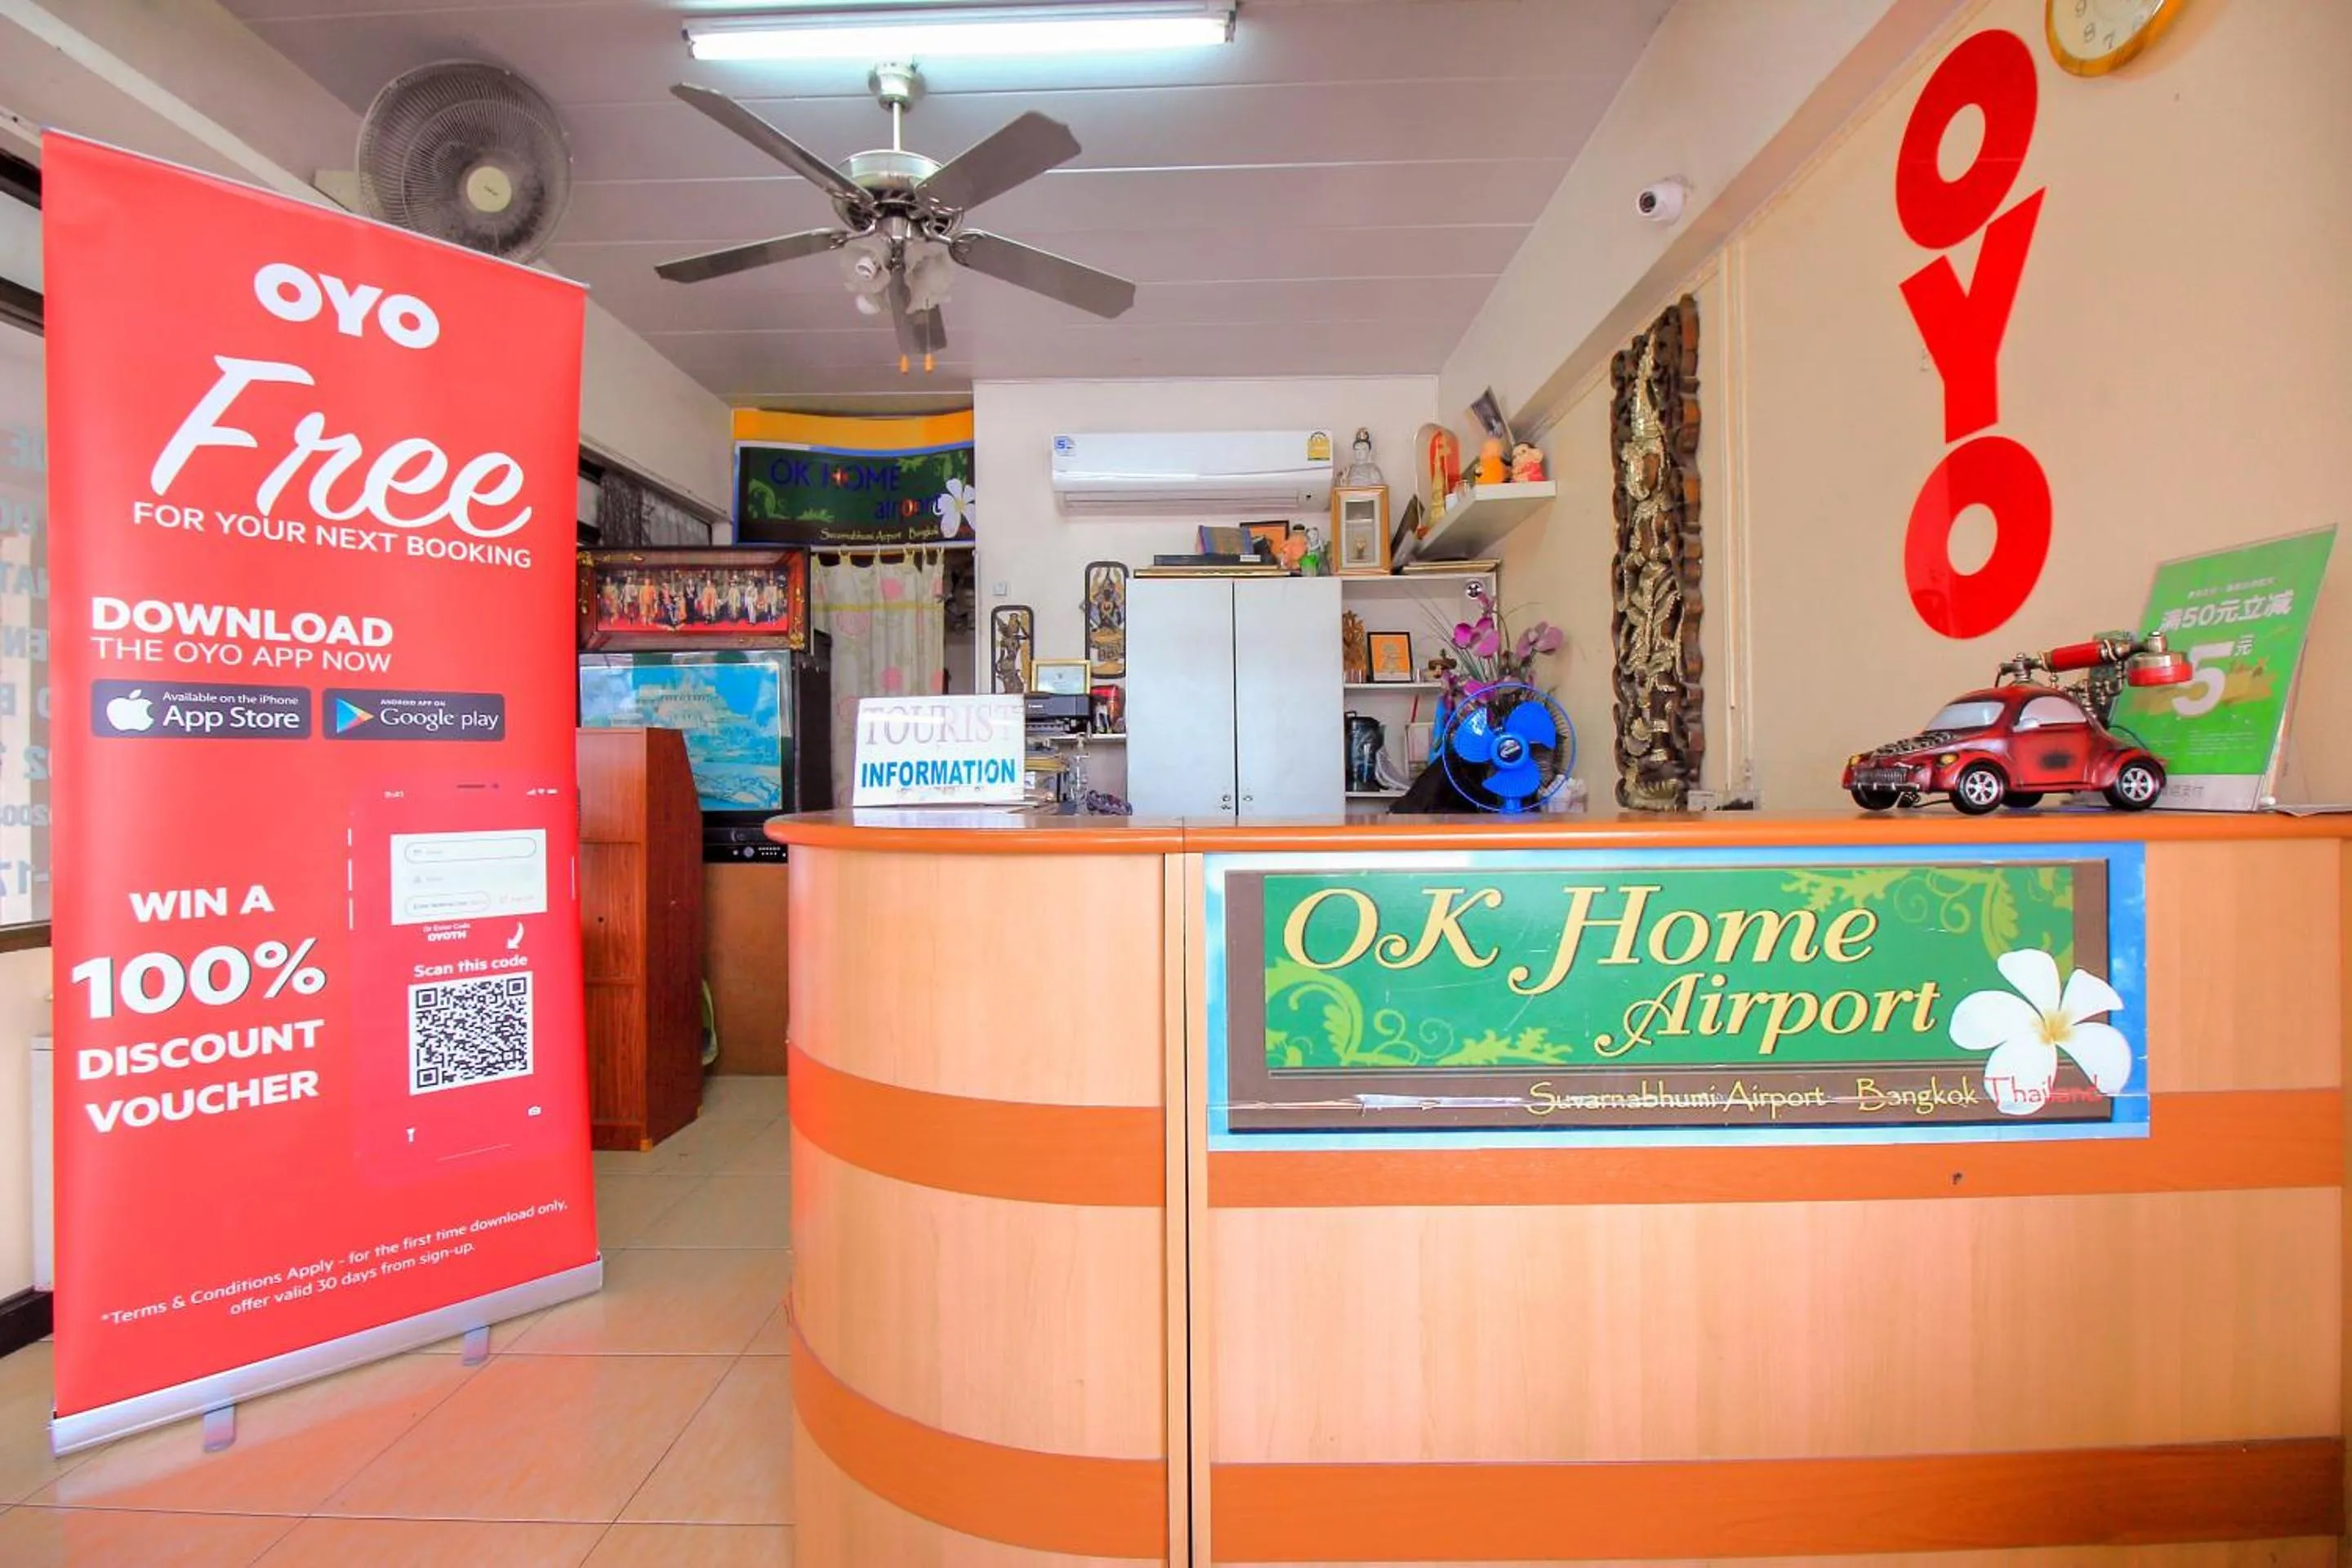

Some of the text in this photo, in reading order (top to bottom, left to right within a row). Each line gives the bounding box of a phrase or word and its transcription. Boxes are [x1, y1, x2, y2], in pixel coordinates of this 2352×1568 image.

[253, 262, 440, 349] OYO
[1895, 29, 2053, 639] OYO
[150, 354, 532, 538] Free
[133, 501, 532, 568] FOR YOUR NEXT BOOKING
[91, 597, 394, 647] DOWNLOAD
[91, 637, 392, 673] THE OYO APP NOW
[163, 692, 299, 706] Available on the iPhone
[163, 706, 300, 733] App Store
[380, 708, 499, 732] Google play
[861, 759, 1016, 788] INFORMATION
[128, 884, 276, 923] WIN A
[413, 954, 528, 978] Scan this code
[1283, 885, 1880, 996] OK Home
[71, 937, 327, 1021] 100%
[1593, 972, 1940, 1058] Airport
[78, 1019, 325, 1080] DISCOUNT
[85, 1071, 319, 1134] VOUCHER
[1526, 1074, 2103, 1120] Suvarnabhumi Airport Bangkok Thailand
[172, 1295, 186, 1309] &
[190, 1274, 283, 1305] Conditions
[287, 1258, 334, 1285] Apply
[348, 1250, 370, 1263] for
[375, 1243, 399, 1258] the
[403, 1232, 433, 1251] first
[436, 1224, 467, 1241] time
[470, 1205, 535, 1232] download
[229, 1295, 270, 1316] offer
[274, 1281, 314, 1303] valid
[317, 1276, 337, 1293] 30
[341, 1265, 377, 1288] days
[381, 1256, 416, 1274] from
